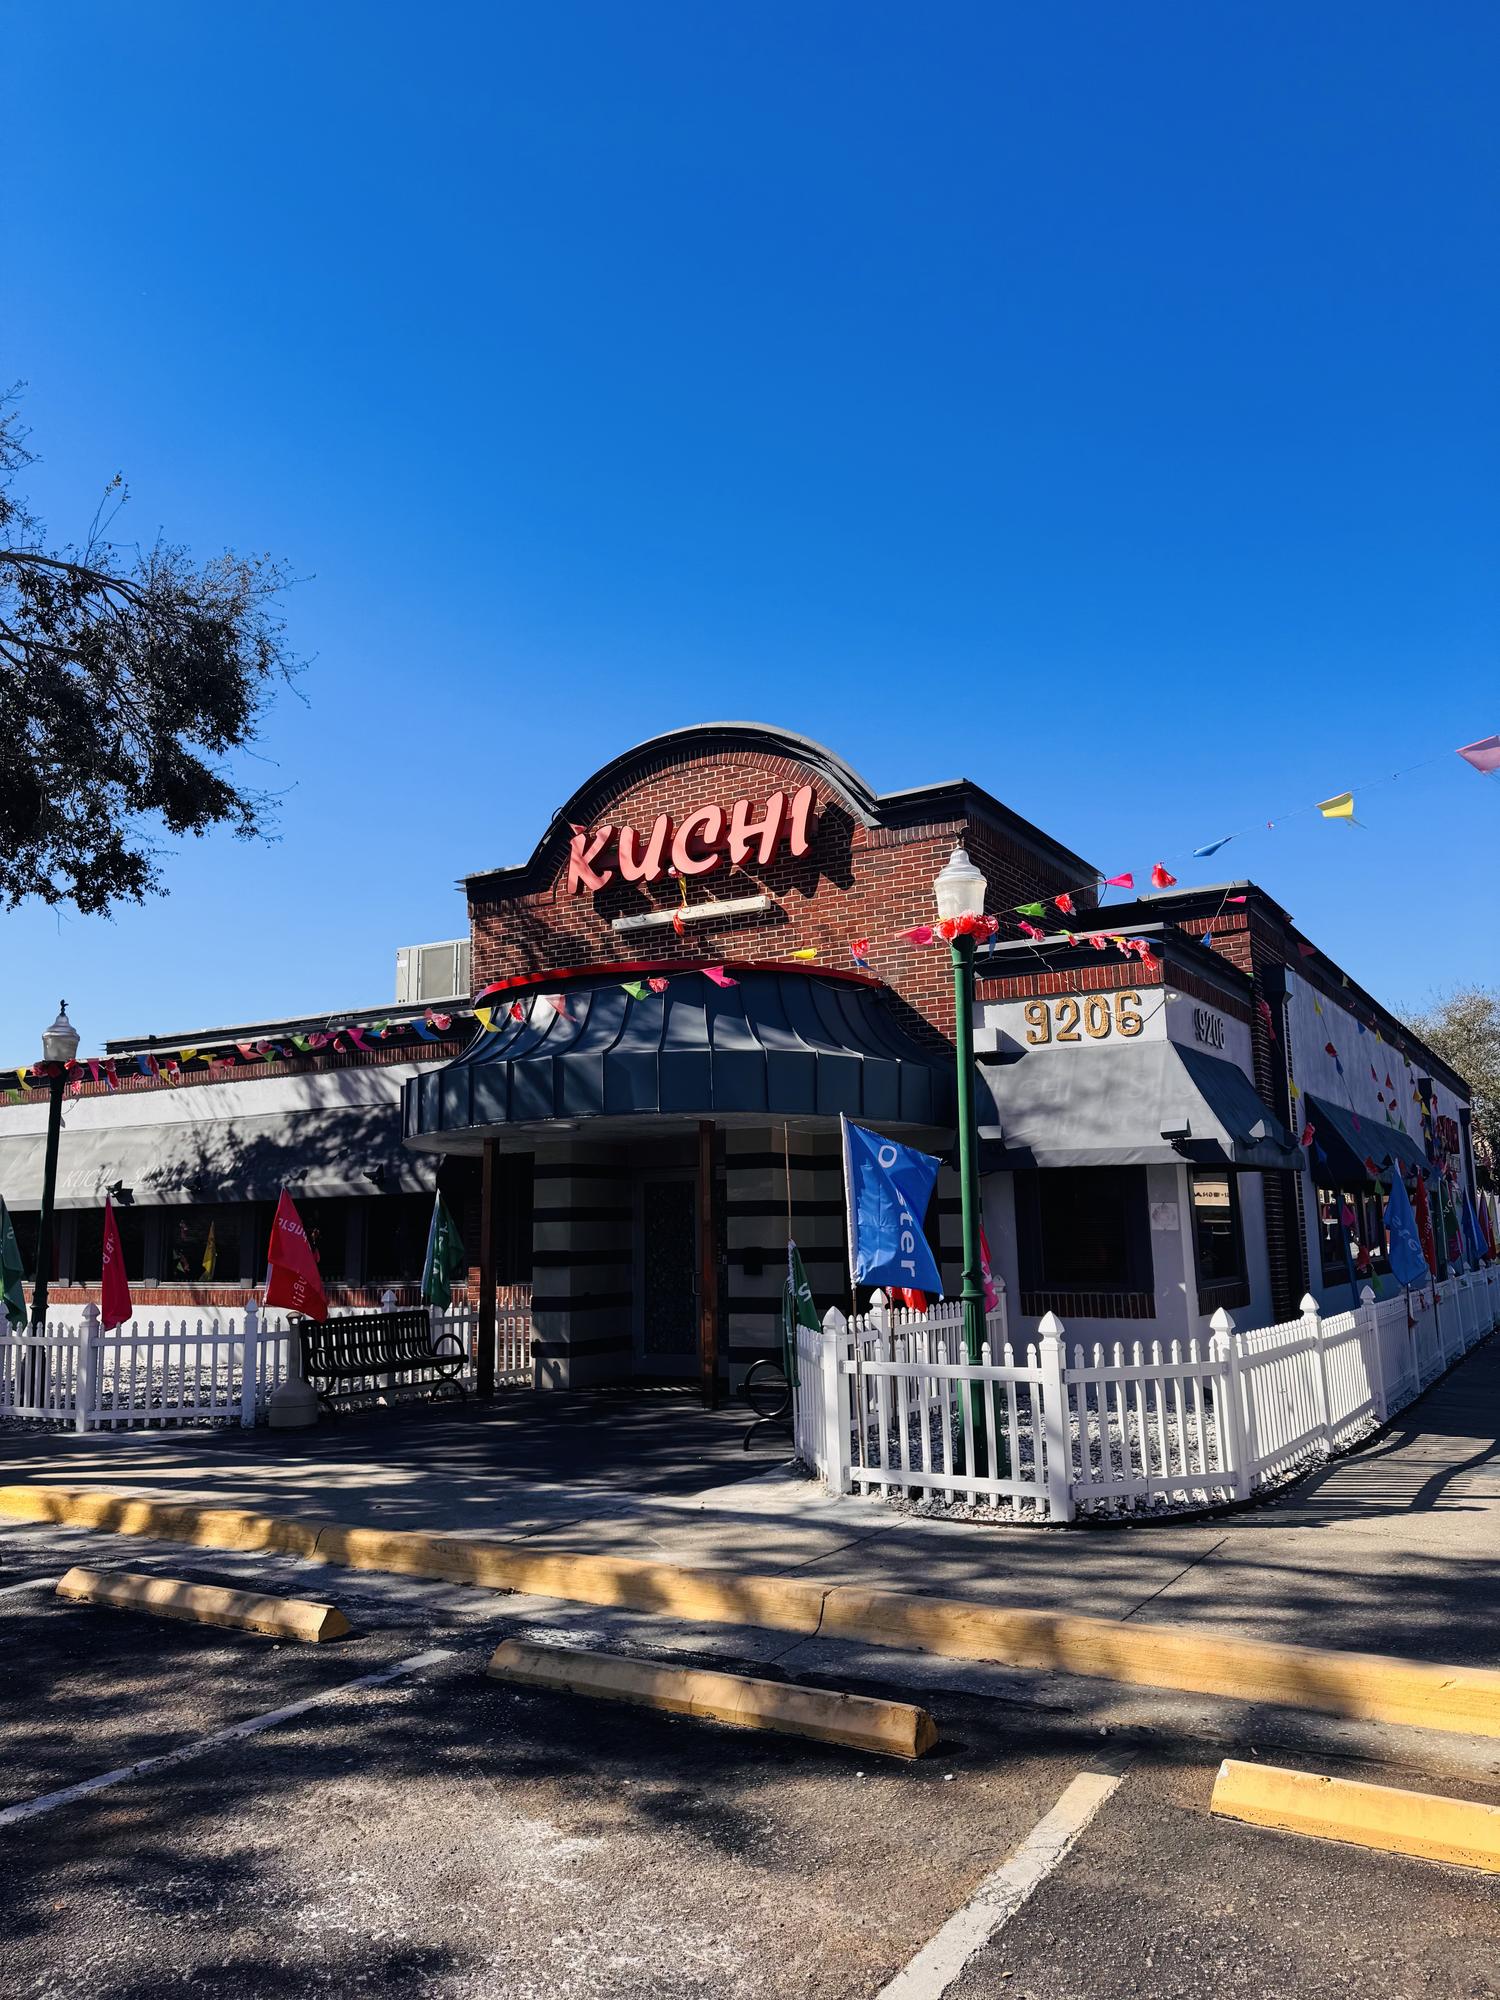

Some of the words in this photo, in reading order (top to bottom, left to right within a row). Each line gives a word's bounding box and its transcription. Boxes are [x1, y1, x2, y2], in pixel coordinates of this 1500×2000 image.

[567, 785, 817, 894] KUCHI
[1024, 991, 1142, 1044] 9206
[1194, 1008, 1226, 1050] 9206
[877, 1144, 916, 1278] Oster
